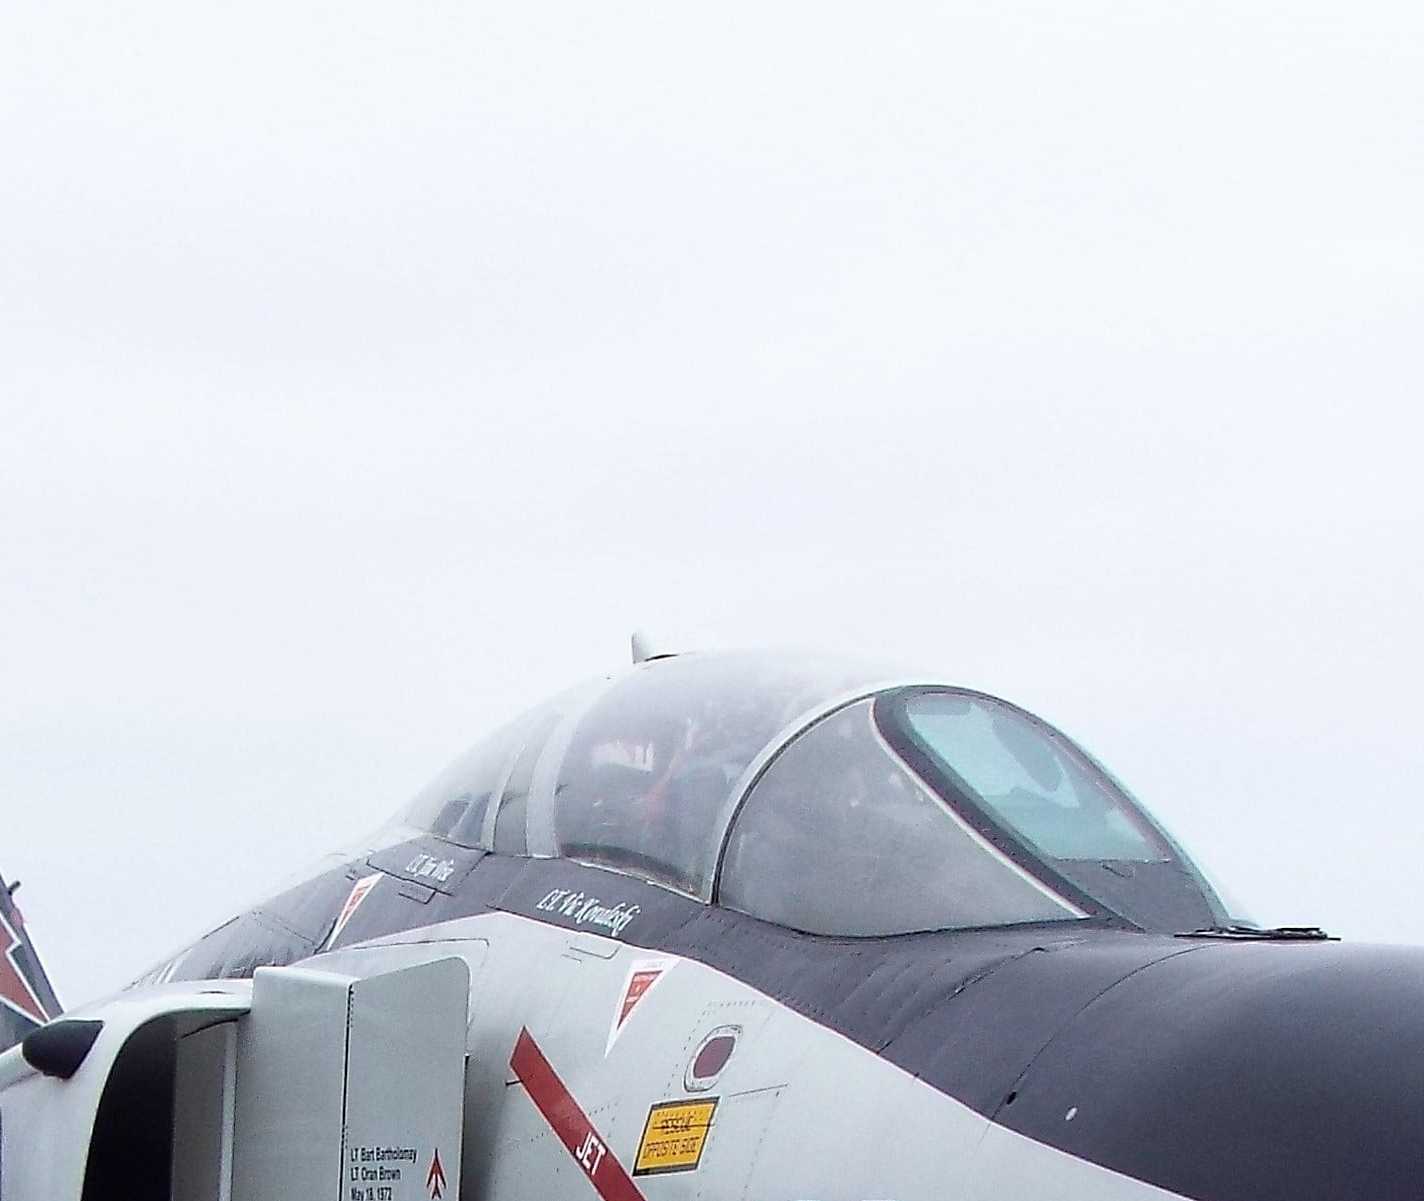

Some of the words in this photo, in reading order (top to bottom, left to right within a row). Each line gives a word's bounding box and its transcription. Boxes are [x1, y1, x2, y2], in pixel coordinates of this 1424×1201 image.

[350, 1149, 358, 1162] LT
[576, 1131, 607, 1176] JET
[350, 1167, 358, 1181] LT
[378, 1166, 401, 1181] Brown
[377, 1187, 392, 1201] 1972
